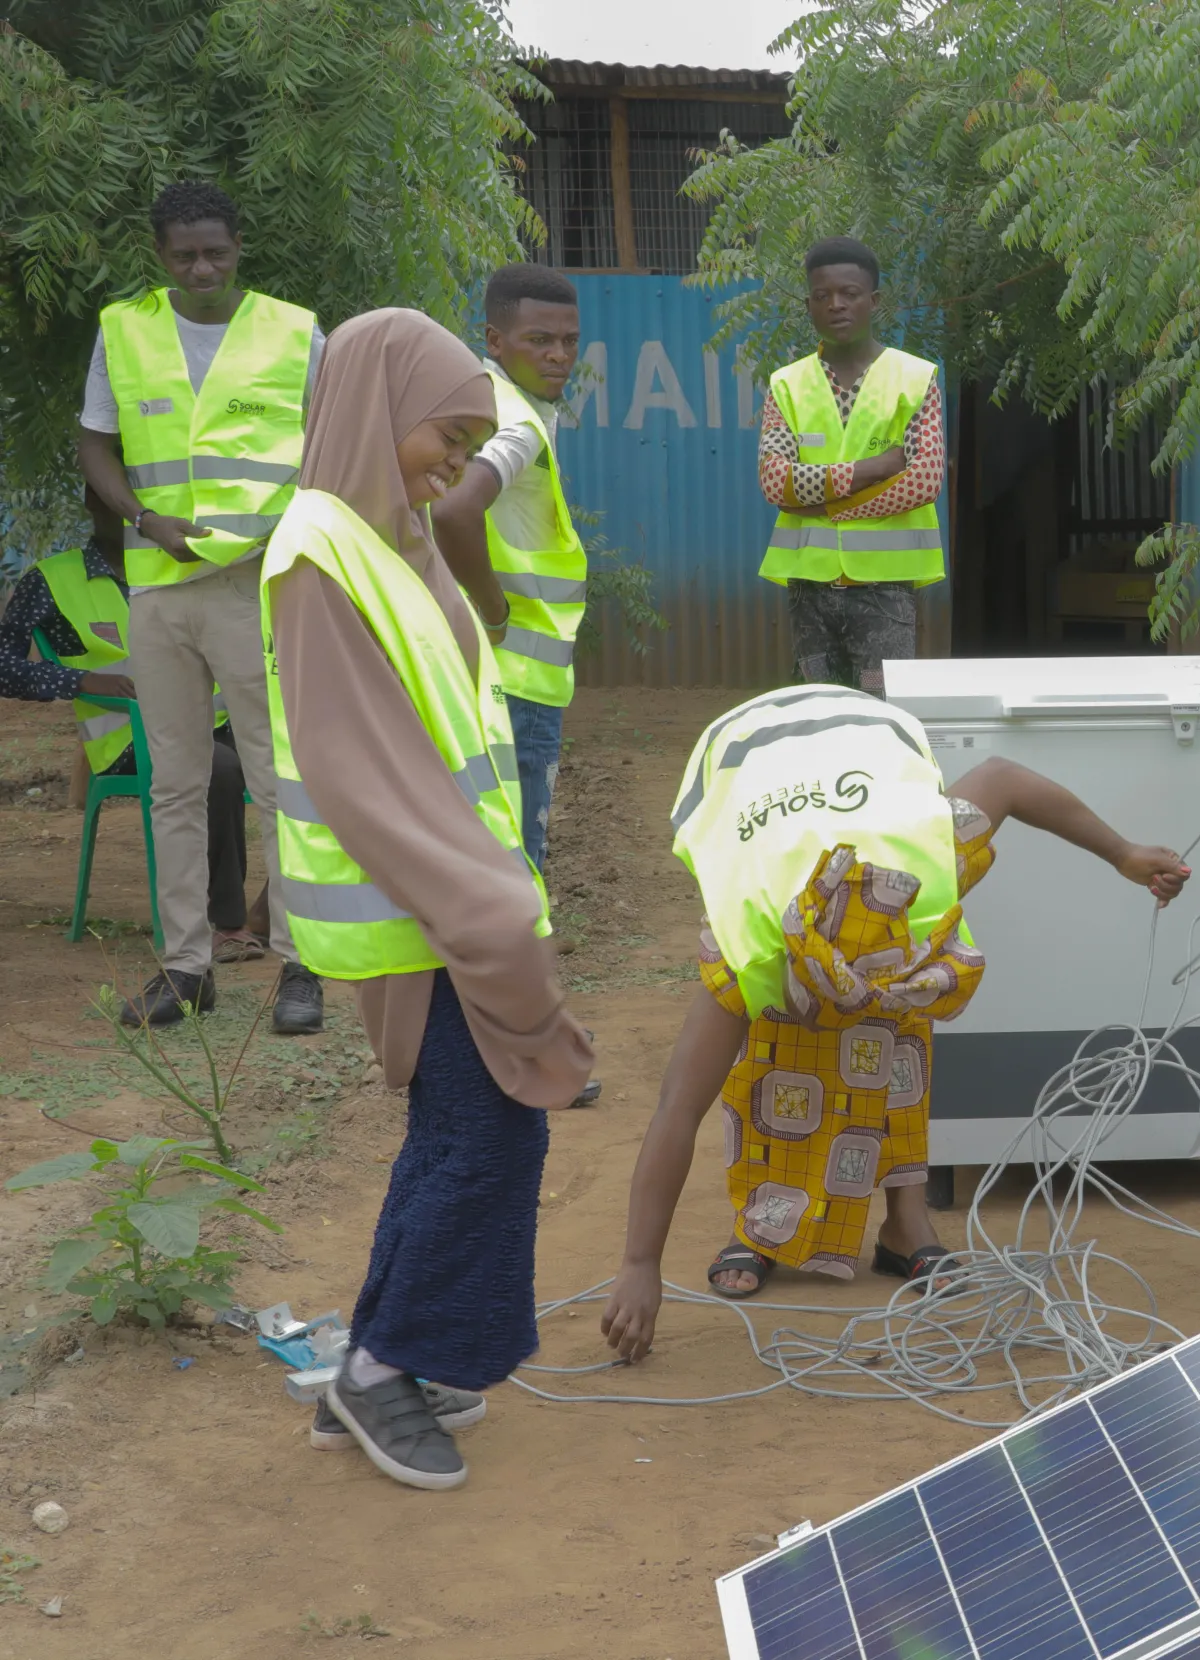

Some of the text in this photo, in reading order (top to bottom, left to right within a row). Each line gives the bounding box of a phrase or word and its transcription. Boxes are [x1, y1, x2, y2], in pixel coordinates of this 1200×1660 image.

[239, 402, 266, 413] SOLAR
[736, 779, 821, 828] FREEZE
[737, 792, 827, 842] SOLAR
